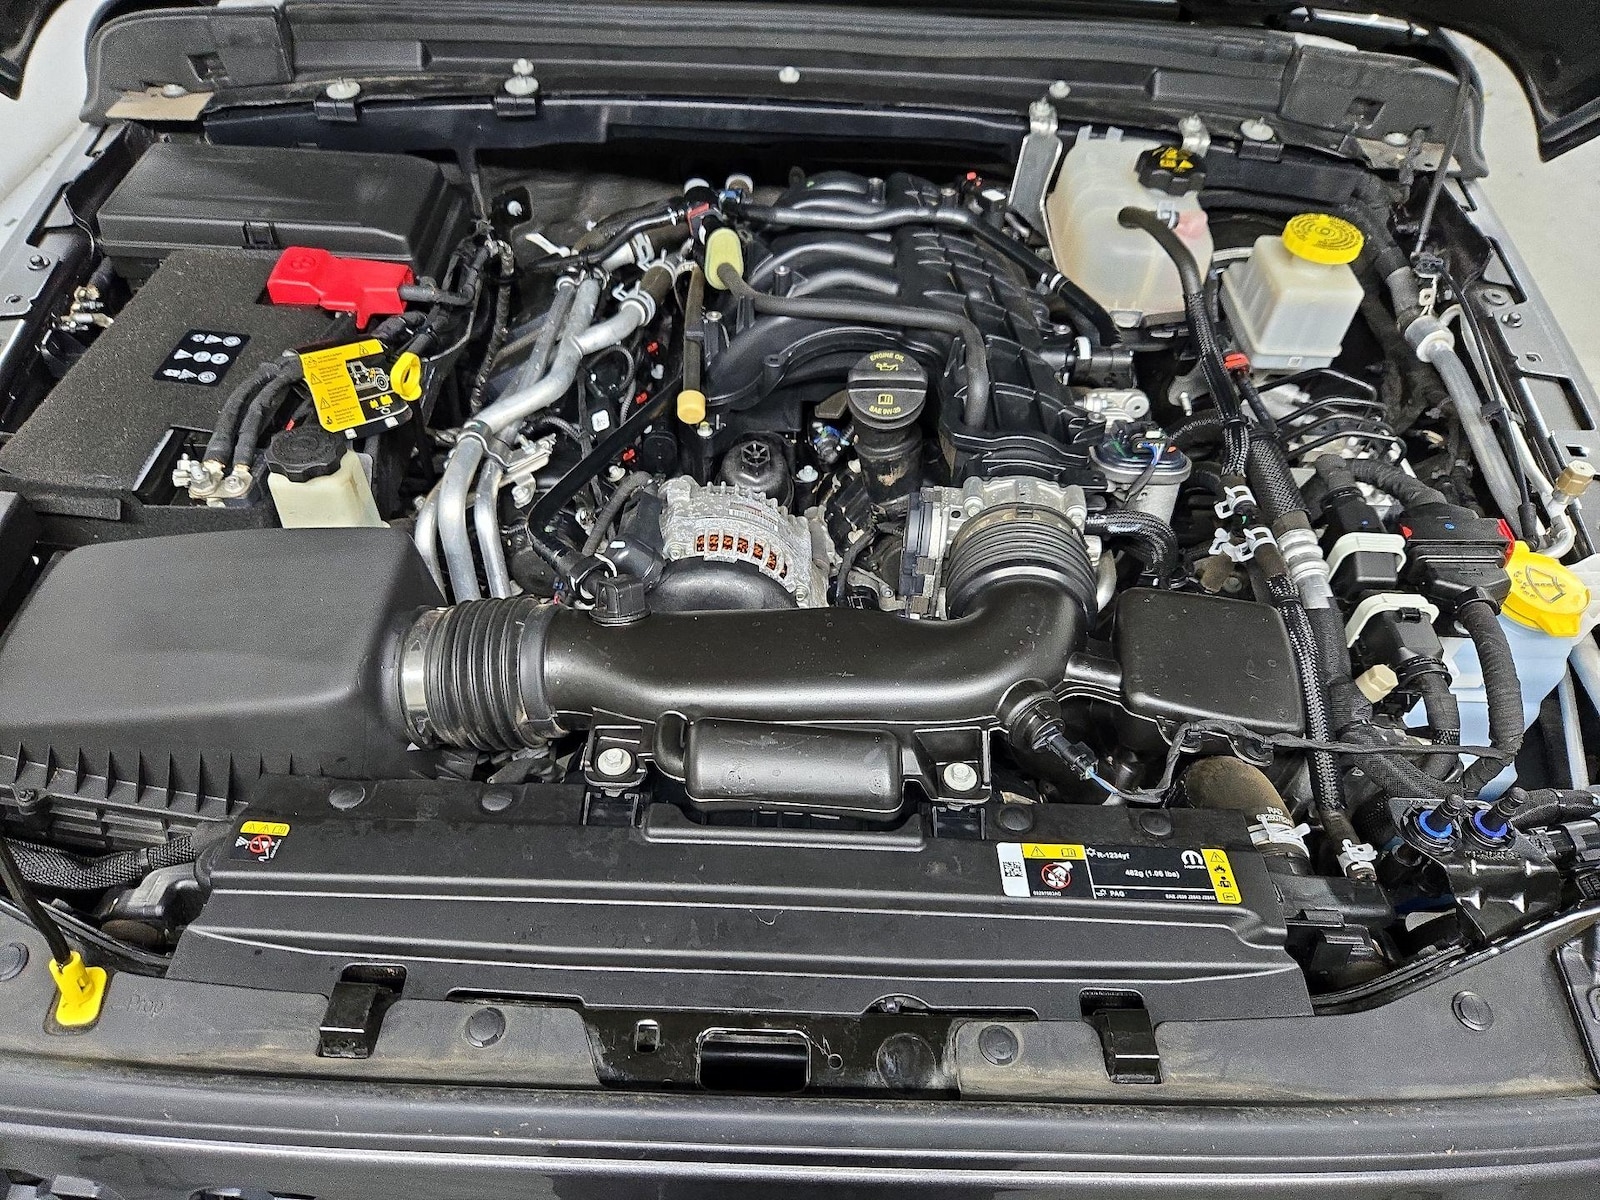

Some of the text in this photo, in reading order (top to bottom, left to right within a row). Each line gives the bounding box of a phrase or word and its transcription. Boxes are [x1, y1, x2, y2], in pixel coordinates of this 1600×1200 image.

[869, 352, 905, 362] ENGINE OIL
[868, 405, 882, 415] SAE
[1266, 806, 1284, 816] RAD
[1096, 851, 1130, 860] R-1234yf
[1125, 869, 1144, 878] 482g
[1164, 870, 1180, 879] lbs)
[1109, 890, 1125, 898] PAG
